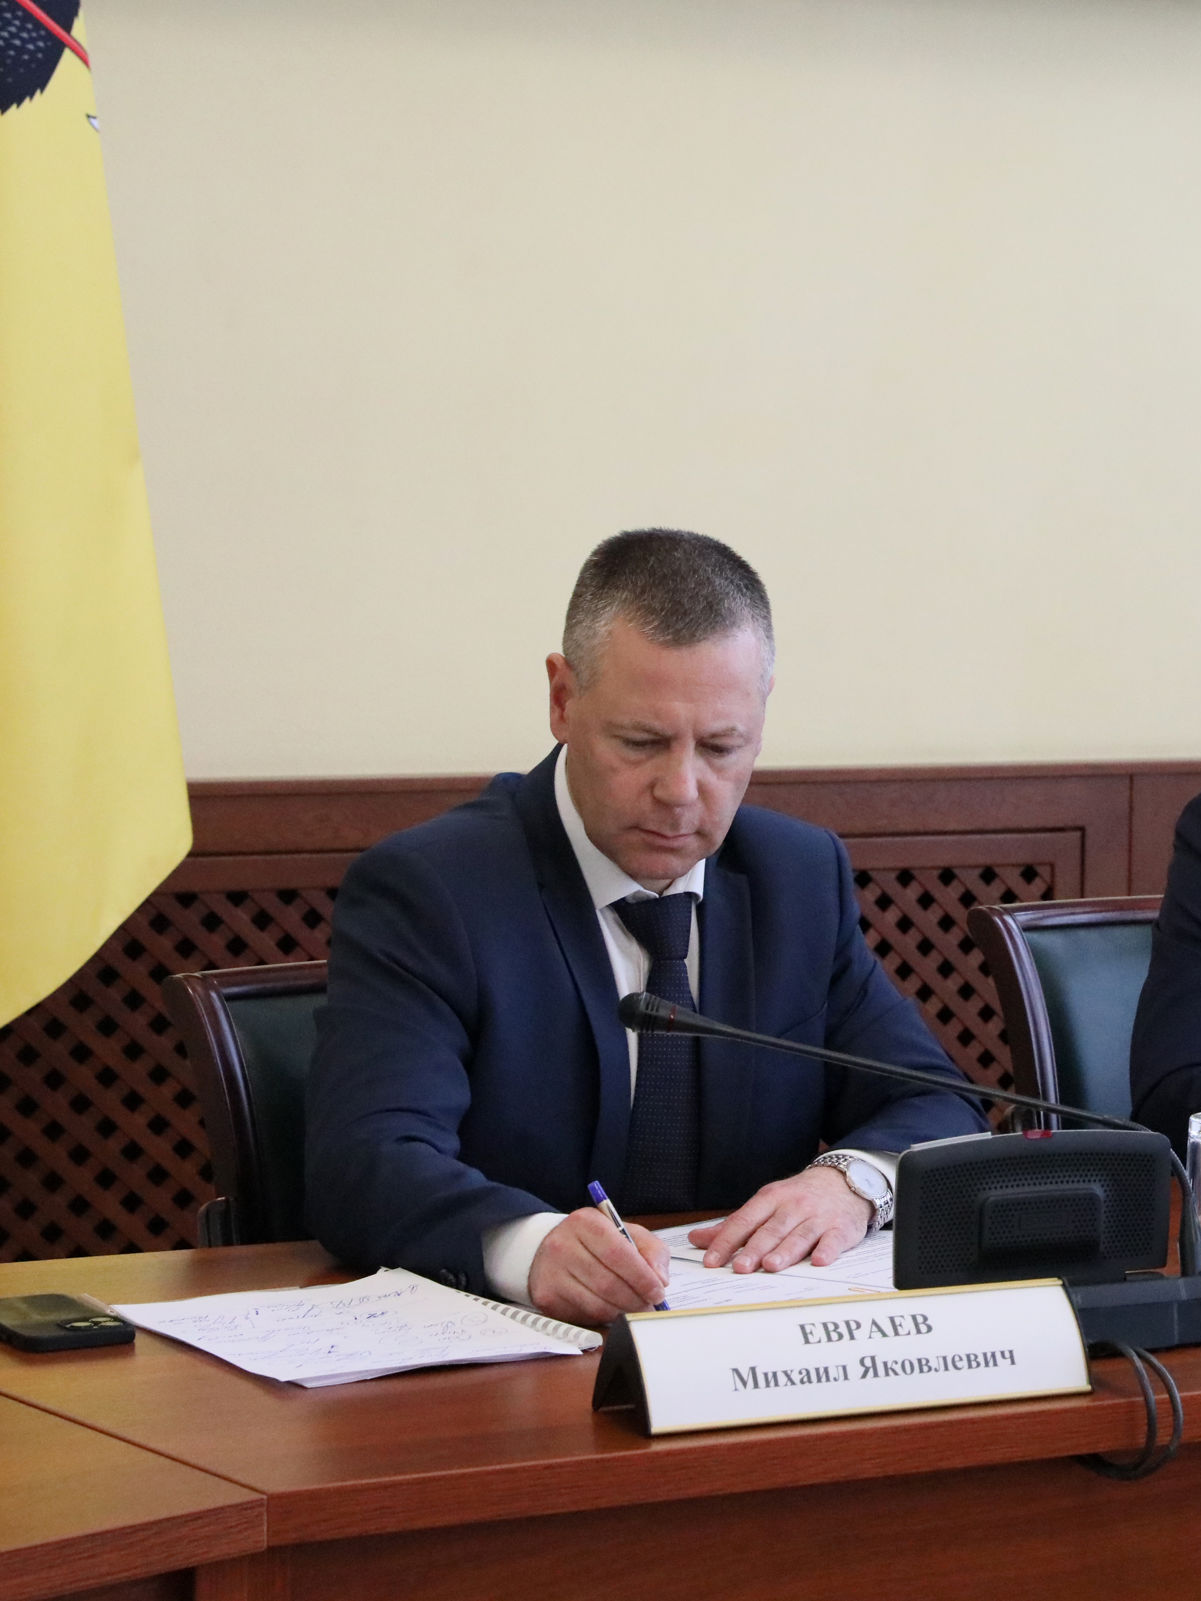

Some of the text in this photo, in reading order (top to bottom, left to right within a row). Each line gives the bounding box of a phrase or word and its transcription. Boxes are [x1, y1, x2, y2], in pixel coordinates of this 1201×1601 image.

[798, 1313, 934, 1345] ЕВРАЕВ
[731, 1348, 1018, 1392] Михаил Яковлевич
